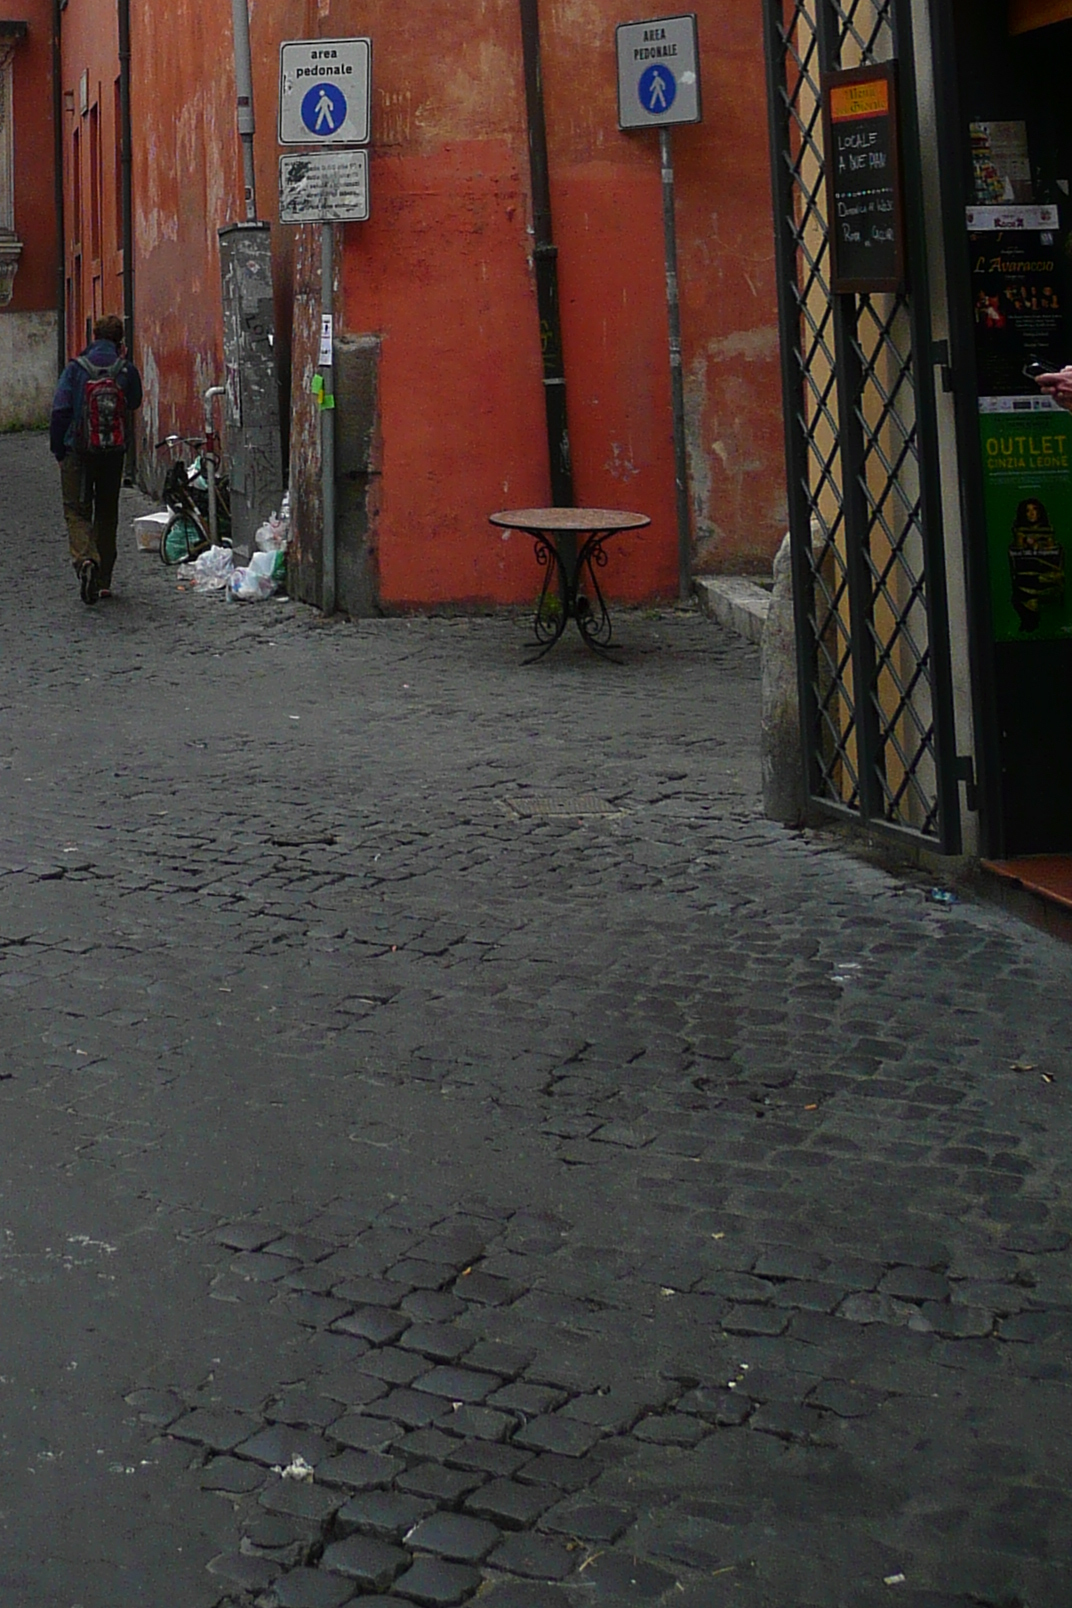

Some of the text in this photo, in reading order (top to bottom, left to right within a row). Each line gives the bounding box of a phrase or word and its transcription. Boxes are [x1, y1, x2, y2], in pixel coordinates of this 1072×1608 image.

[642, 27, 666, 43] AREA
[310, 49, 338, 60] area
[633, 43, 678, 61] PEDONALE
[295, 63, 353, 79] pedonale
[838, 132, 878, 150] LOCALE
[986, 435, 1067, 455] OUTLET
[987, 456, 1069, 469] CINZIA LEONE
